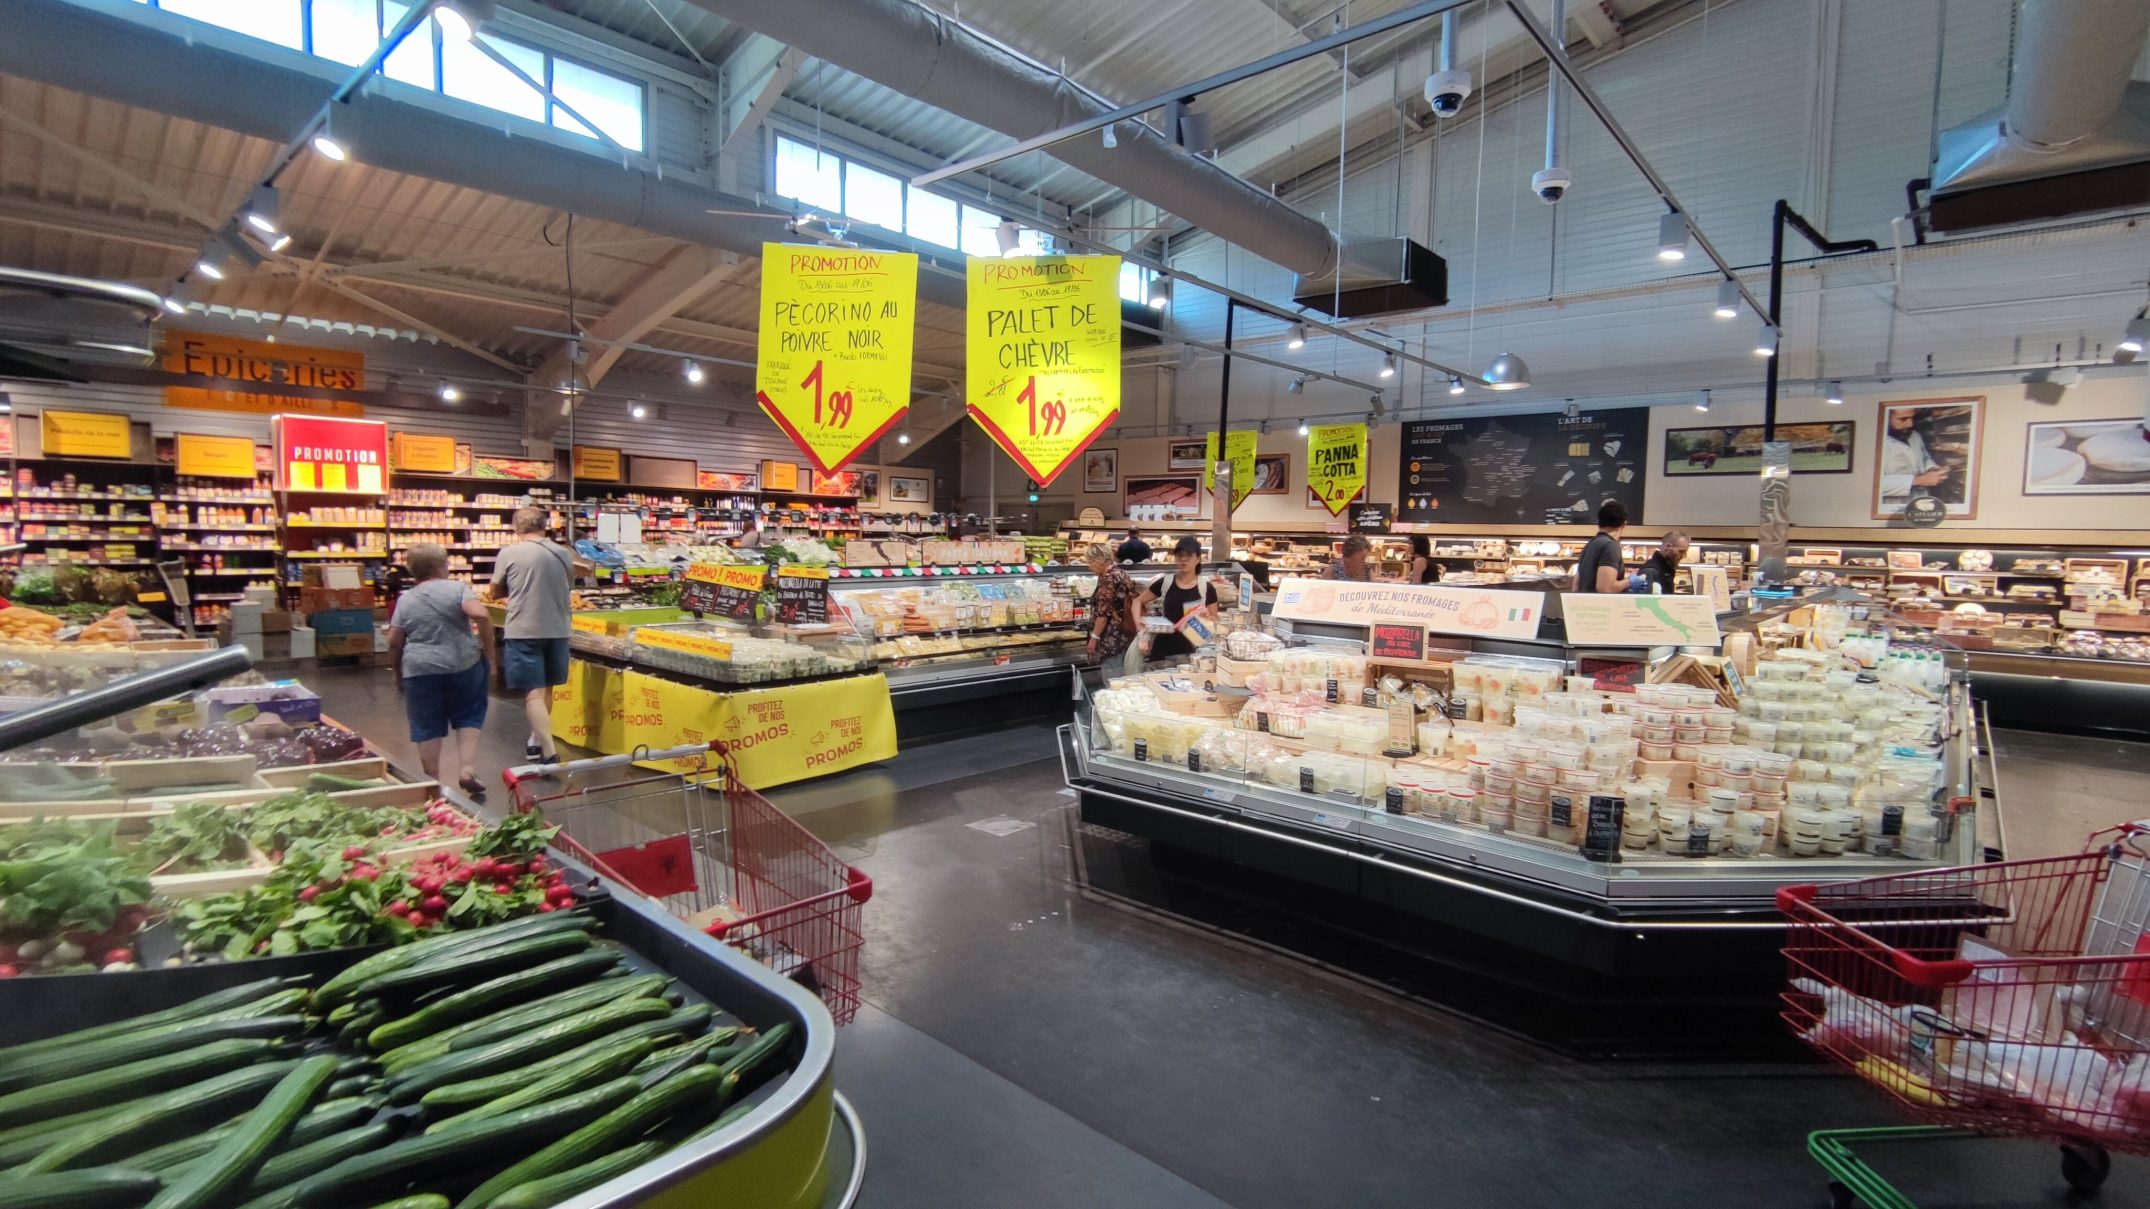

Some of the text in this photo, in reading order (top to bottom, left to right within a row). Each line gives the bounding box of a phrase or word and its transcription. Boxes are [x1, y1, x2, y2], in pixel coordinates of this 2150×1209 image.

[790, 254, 883, 274] PROMOTION
[984, 262, 1086, 284] PROMOTION
[880, 301, 898, 319] AU
[987, 306, 1059, 338] PALET
[1071, 303, 1097, 327] DE
[781, 326, 884, 352] POIVRE NOIR
[998, 338, 1077, 369] CHÈVRE
[1558, 417, 1581, 425] L'ART
[294, 446, 377, 464] PROMOTION
[1315, 443, 1358, 465] PANNA
[1323, 462, 1356, 478] COTTA
[689, 564, 717, 580] PROMO
[725, 571, 758, 586] PROMO
[1339, 590, 1461, 611] DÉCOUVREZ NOS FROMAGES
[1351, 602, 1437, 619] de Méditerranée
[748, 700, 783, 713] PROFITEZ
[625, 714, 663, 726] PROMOS
[759, 710, 785, 723] DE NOS
[830, 716, 861, 729] PROFITEZ
[721, 723, 789, 753] PROMOS
[841, 725, 862, 738] DE NOS
[806, 738, 863, 769] PROMOS
